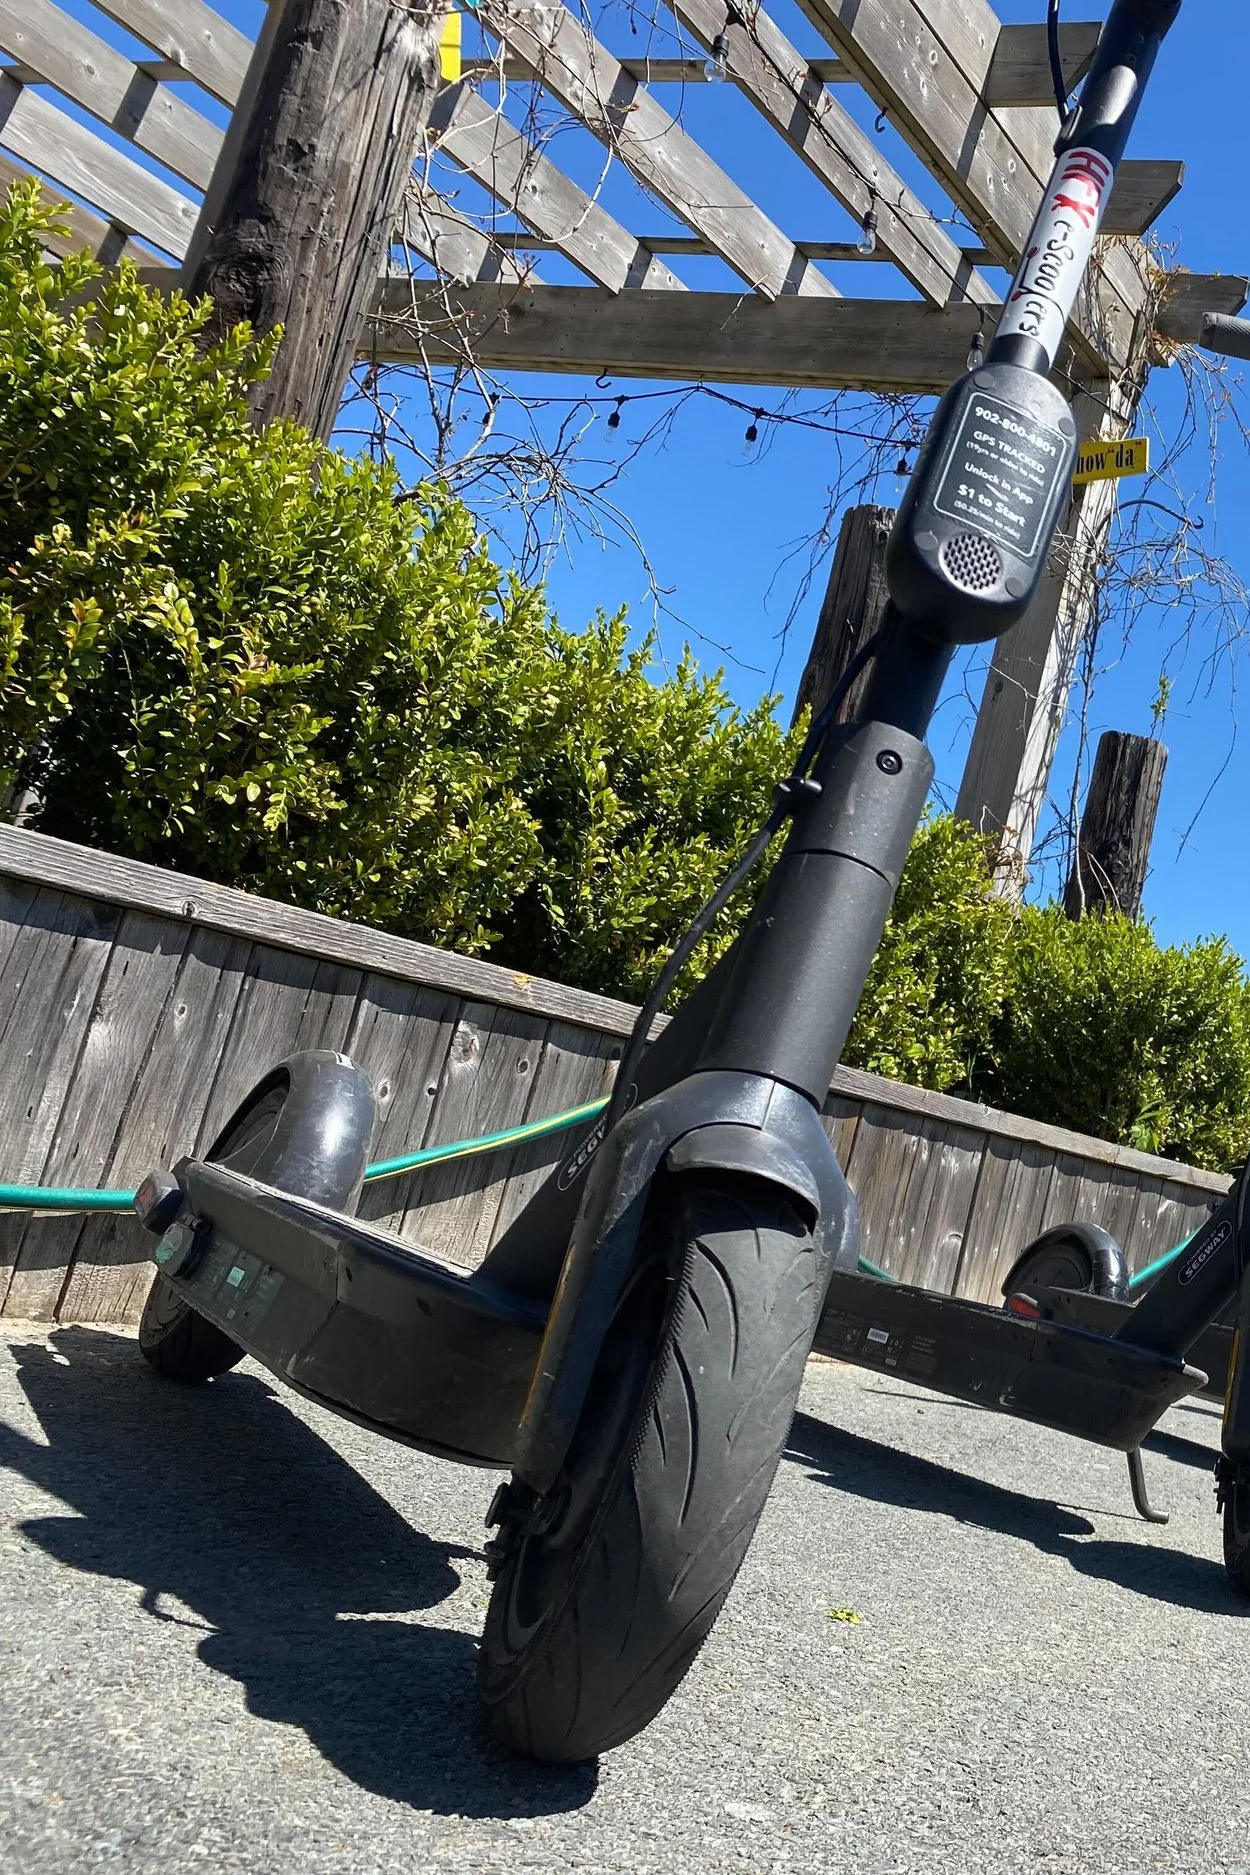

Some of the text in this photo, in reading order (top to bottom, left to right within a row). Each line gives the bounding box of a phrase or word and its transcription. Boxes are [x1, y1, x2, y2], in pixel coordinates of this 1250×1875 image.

[1051, 151, 1109, 229] HFX
[974, 431, 1045, 473] GPS TRACKED
[975, 407, 1056, 456] 902-800-4801
[958, 484, 1026, 527] $1 to Start
[965, 462, 1033, 505] Unlock in App
[1185, 1229, 1225, 1278] SEGWAY
